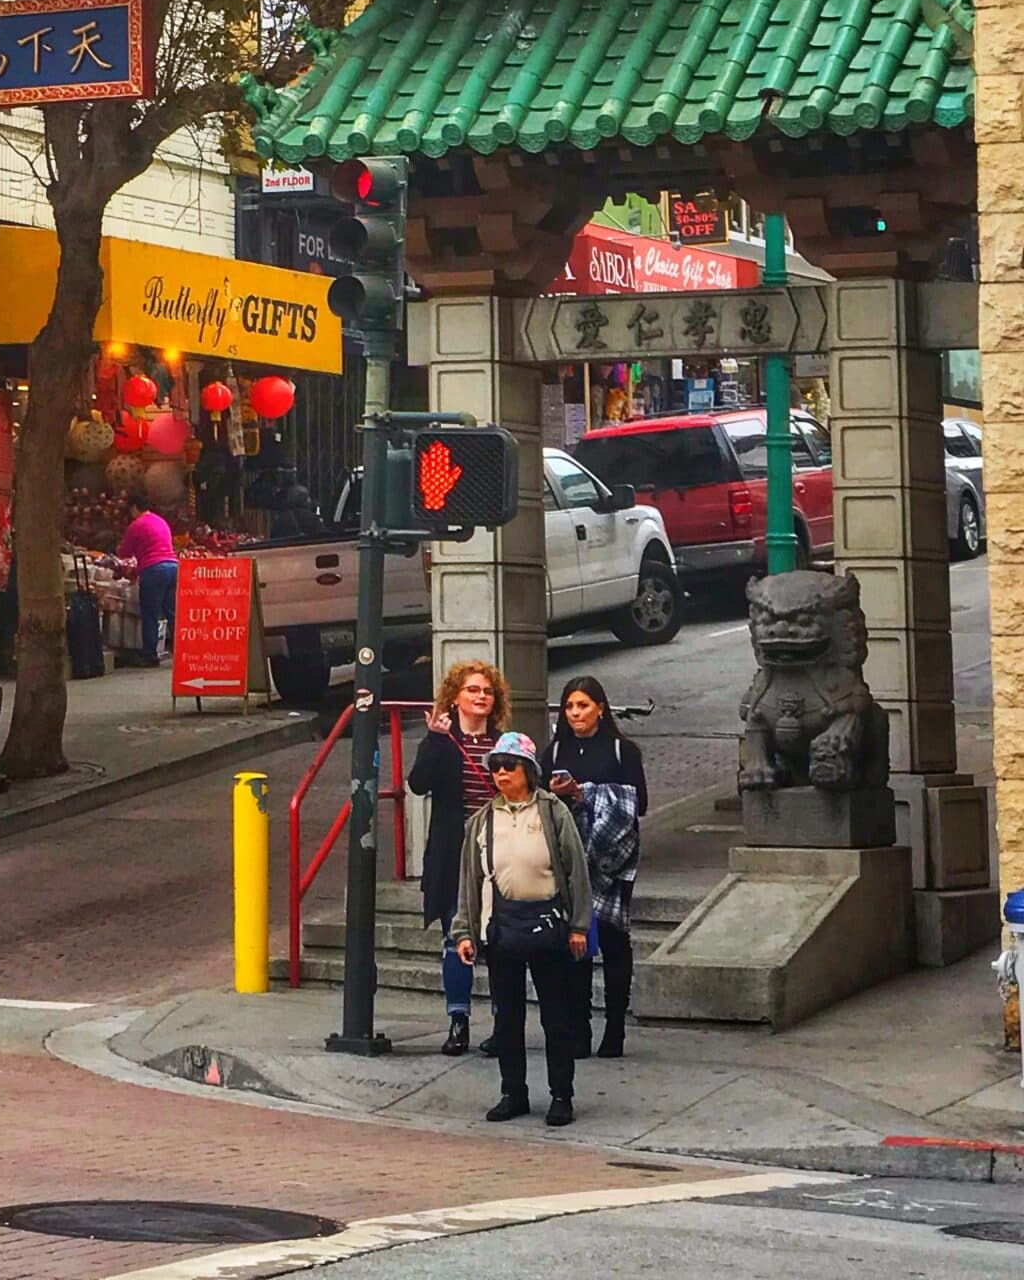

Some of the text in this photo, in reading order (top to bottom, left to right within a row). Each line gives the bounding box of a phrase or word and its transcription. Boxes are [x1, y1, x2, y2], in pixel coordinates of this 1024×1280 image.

[265, 176, 311, 187] 2nd FLOOR
[681, 224, 714, 237] OFF
[298, 233, 325, 259] FOR
[589, 246, 639, 290] SABRA
[645, 246, 680, 277] Choice
[682, 253, 705, 289] Gift
[707, 261, 733, 289] Shop
[143, 276, 318, 347] Butterfly GIFTS
[192, 566, 237, 579] Michael
[189, 608, 237, 622] UP TO
[180, 627, 245, 641] 70% OFF
